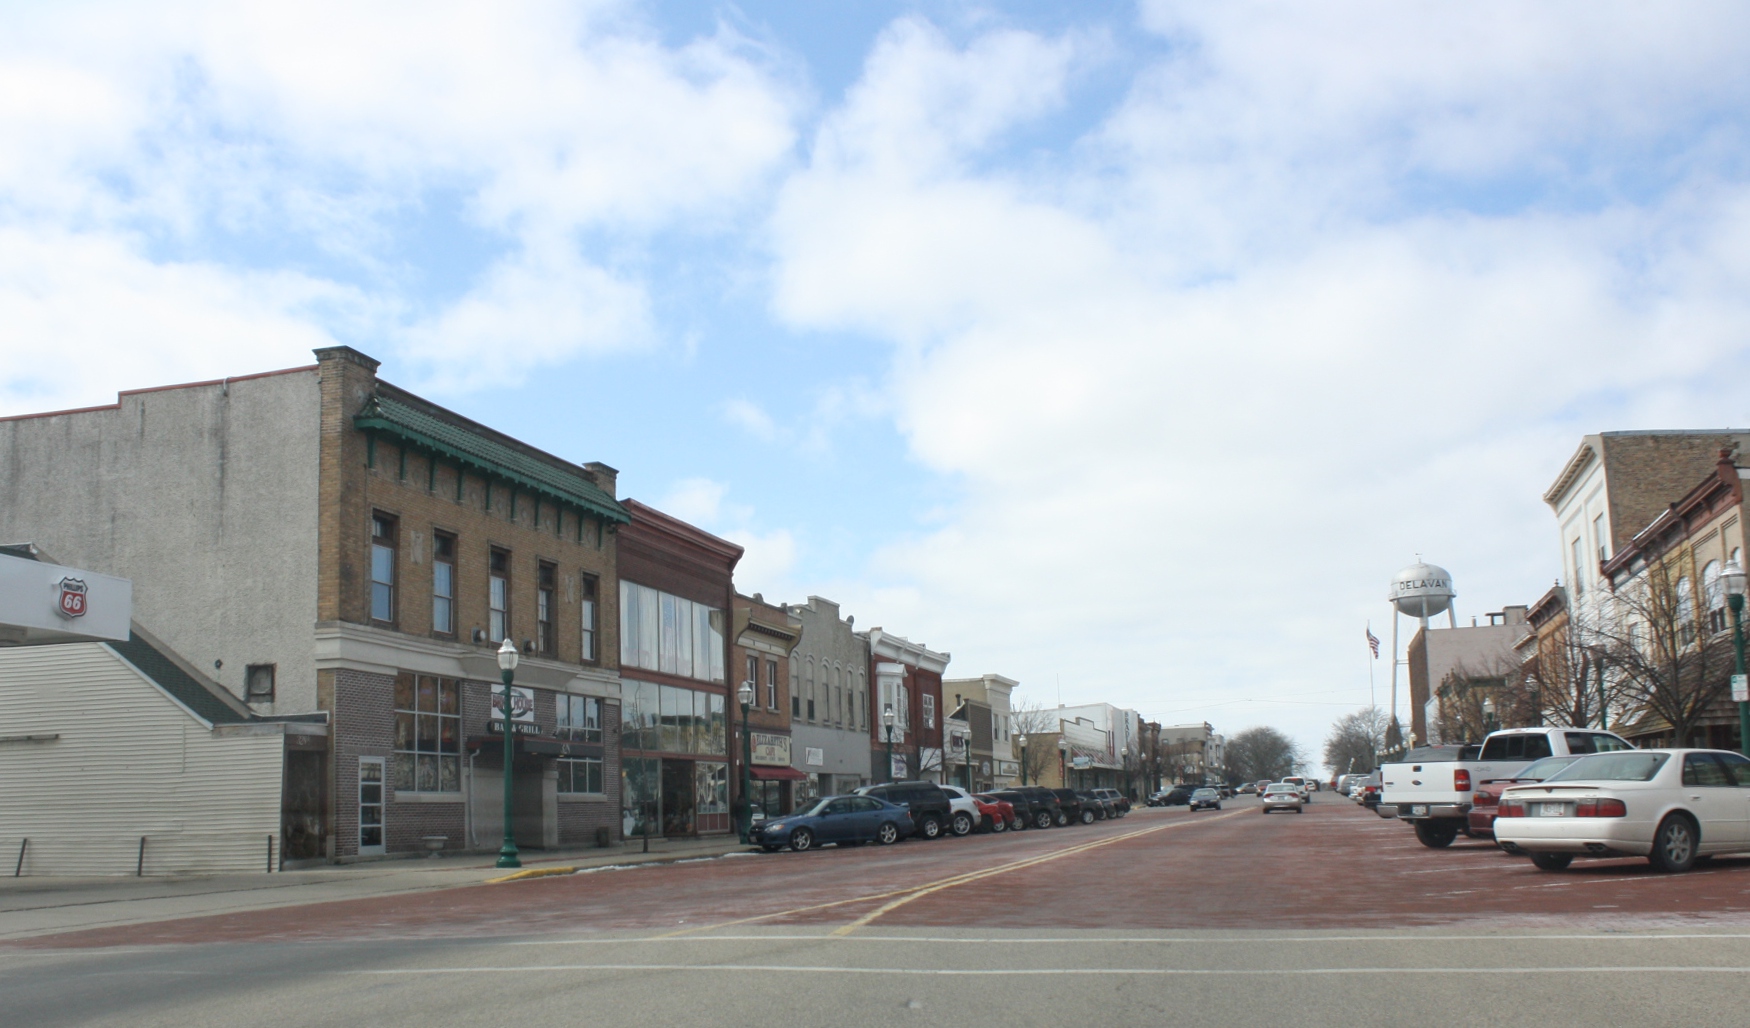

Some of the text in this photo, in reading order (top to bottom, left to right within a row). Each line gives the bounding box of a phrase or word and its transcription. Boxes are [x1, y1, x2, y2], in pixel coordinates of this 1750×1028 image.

[1399, 579, 1448, 590] DELAVAN
[64, 594, 82, 610] 66
[494, 722, 505, 732] BA
[518, 725, 541, 735] GRILL
